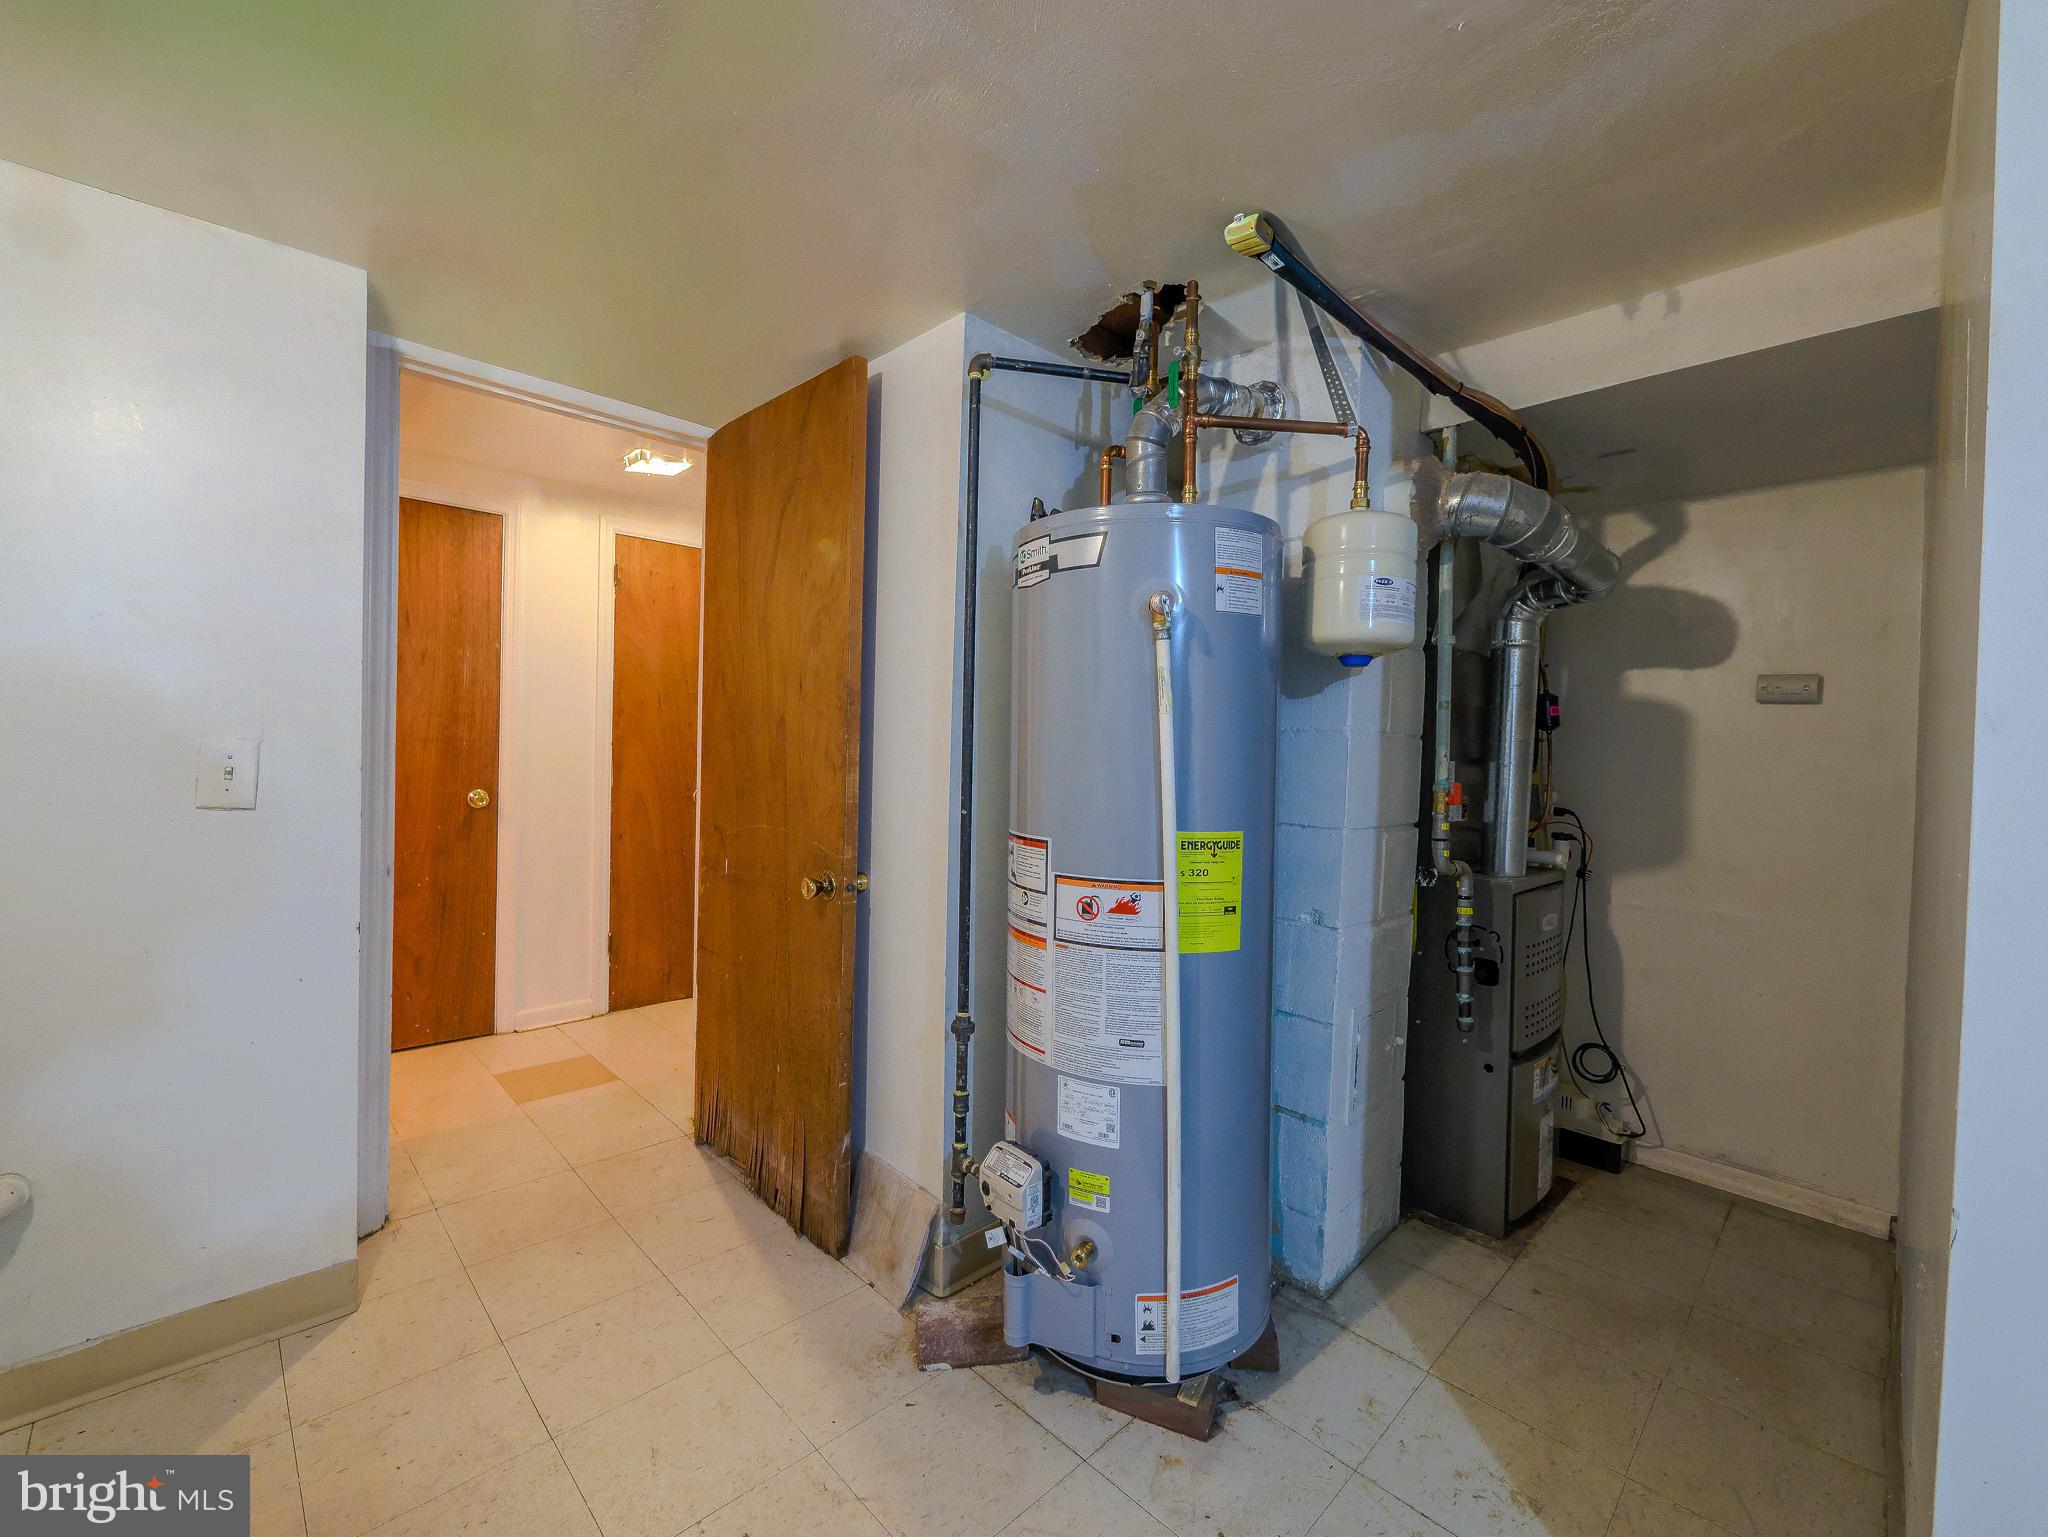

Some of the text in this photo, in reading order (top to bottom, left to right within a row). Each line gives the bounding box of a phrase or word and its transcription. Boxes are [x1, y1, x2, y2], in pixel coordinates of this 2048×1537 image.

[1026, 544, 1048, 560] Smith
[1180, 840, 1240, 851] ENERGYGUIDE
[1188, 868, 1209, 877] 320
